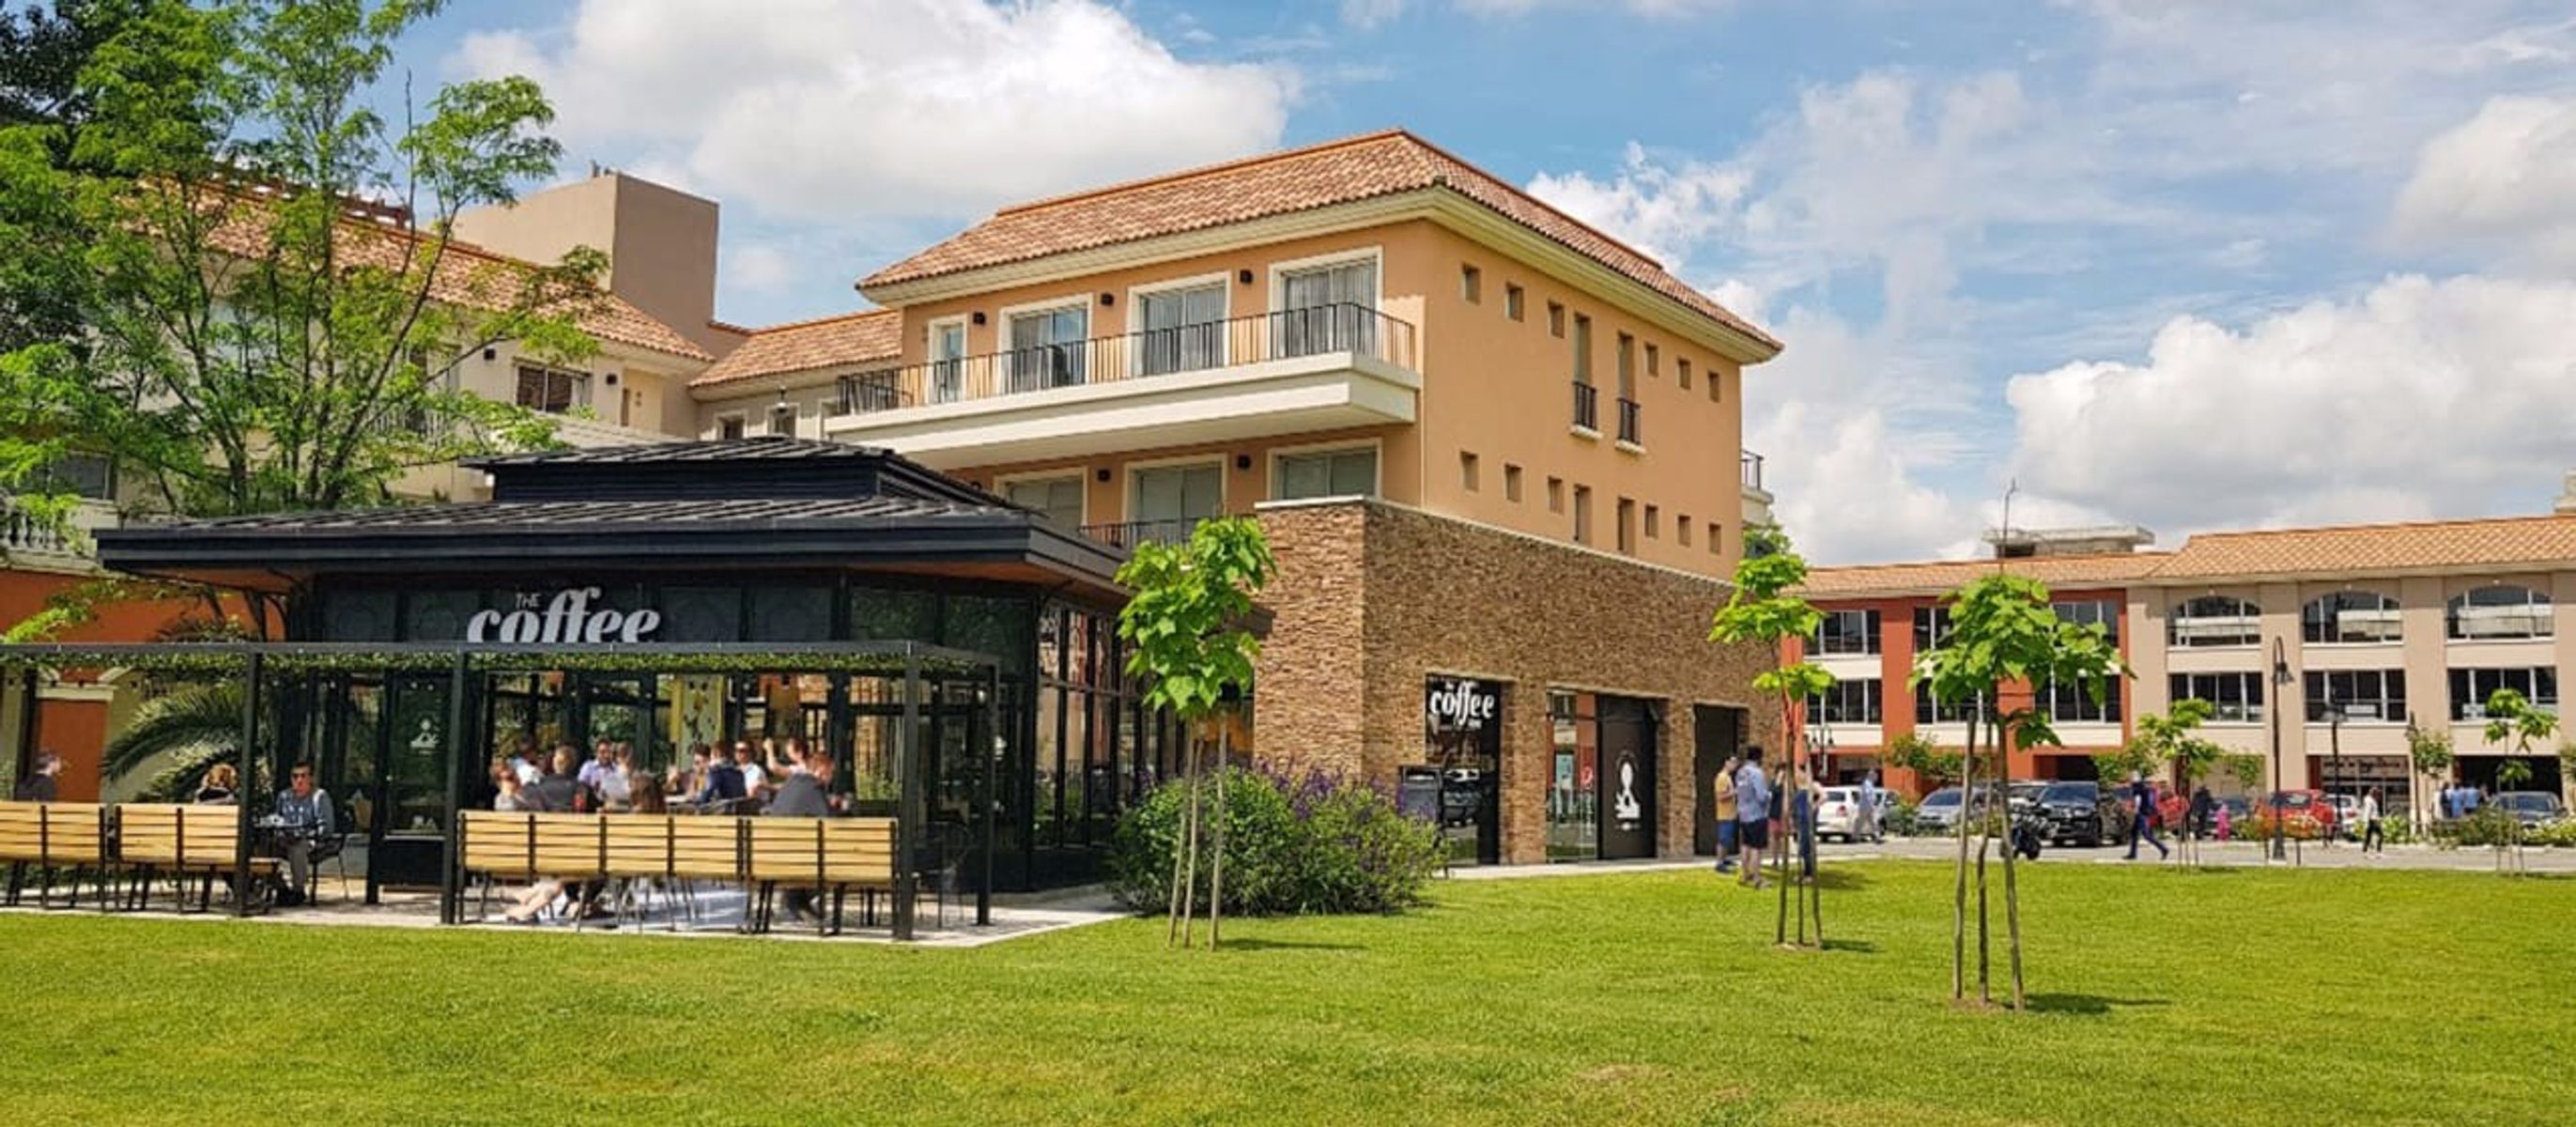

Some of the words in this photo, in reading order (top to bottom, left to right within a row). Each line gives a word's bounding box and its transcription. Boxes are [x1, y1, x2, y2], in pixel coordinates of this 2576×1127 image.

[467, 586, 660, 643] coffee
[516, 593, 542, 610] THE
[1429, 680, 1495, 726] coffee
